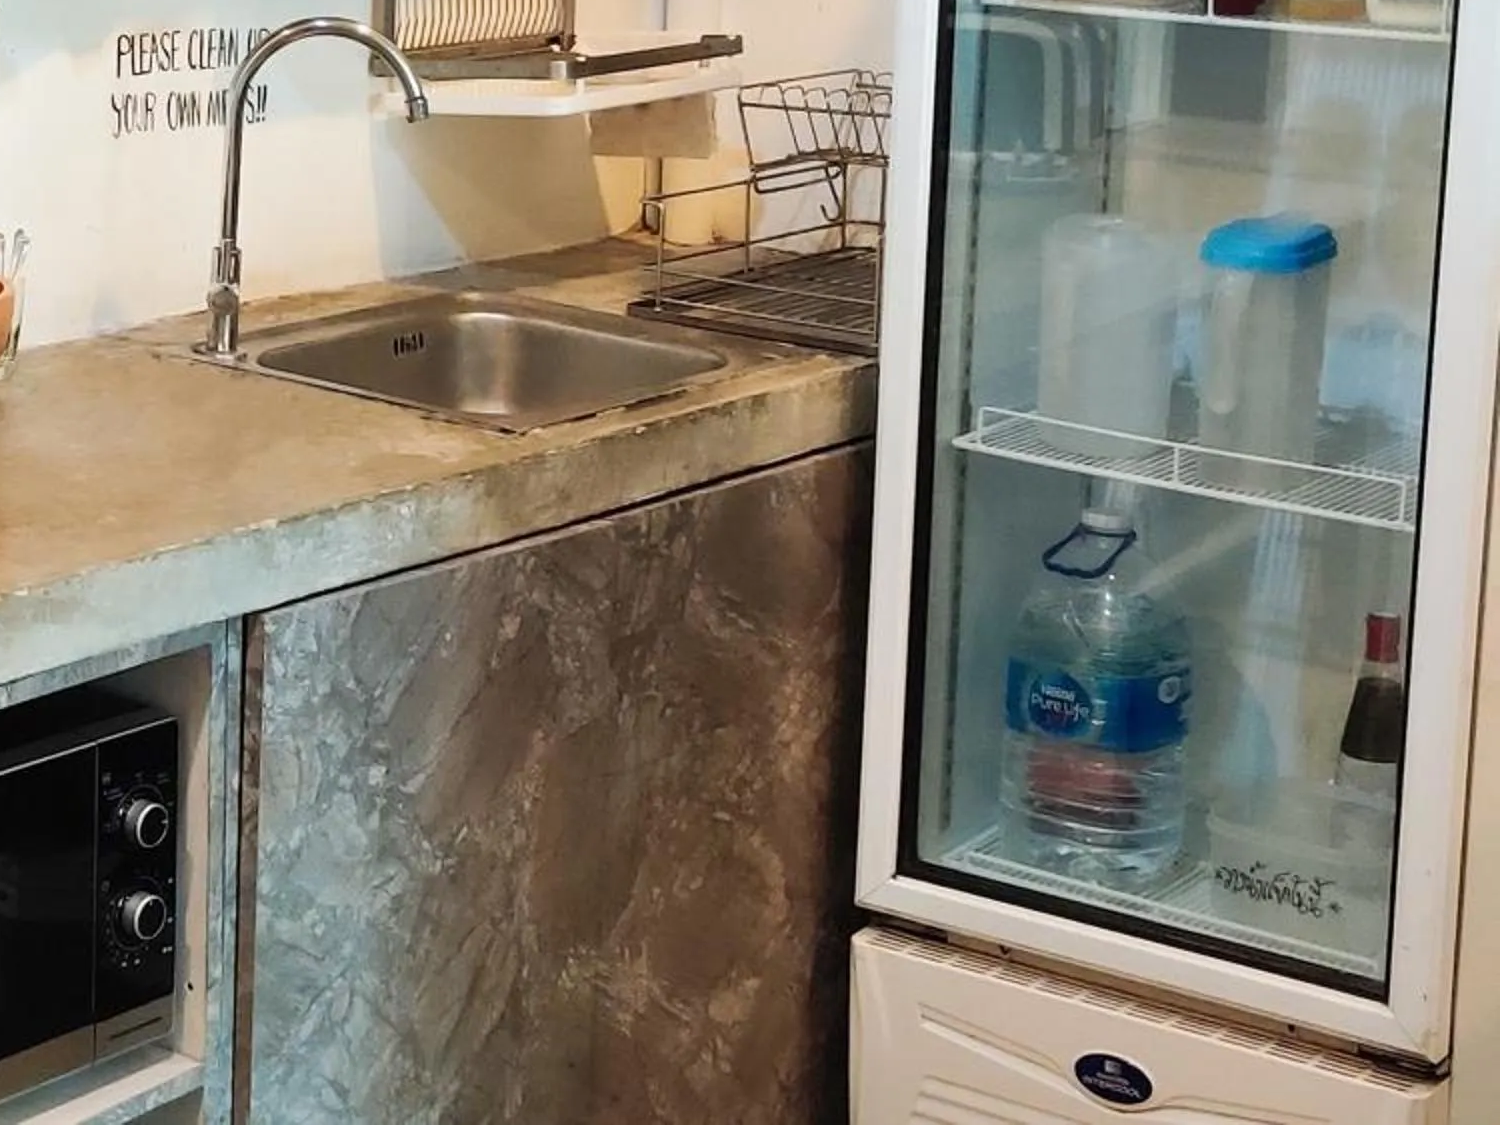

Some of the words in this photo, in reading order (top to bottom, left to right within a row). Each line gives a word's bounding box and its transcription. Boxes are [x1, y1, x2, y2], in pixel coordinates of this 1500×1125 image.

[116, 30, 181, 79] PLEASE
[187, 27, 239, 70] CLEAN
[110, 90, 157, 140] YOUR
[165, 90, 201, 132] OWN
